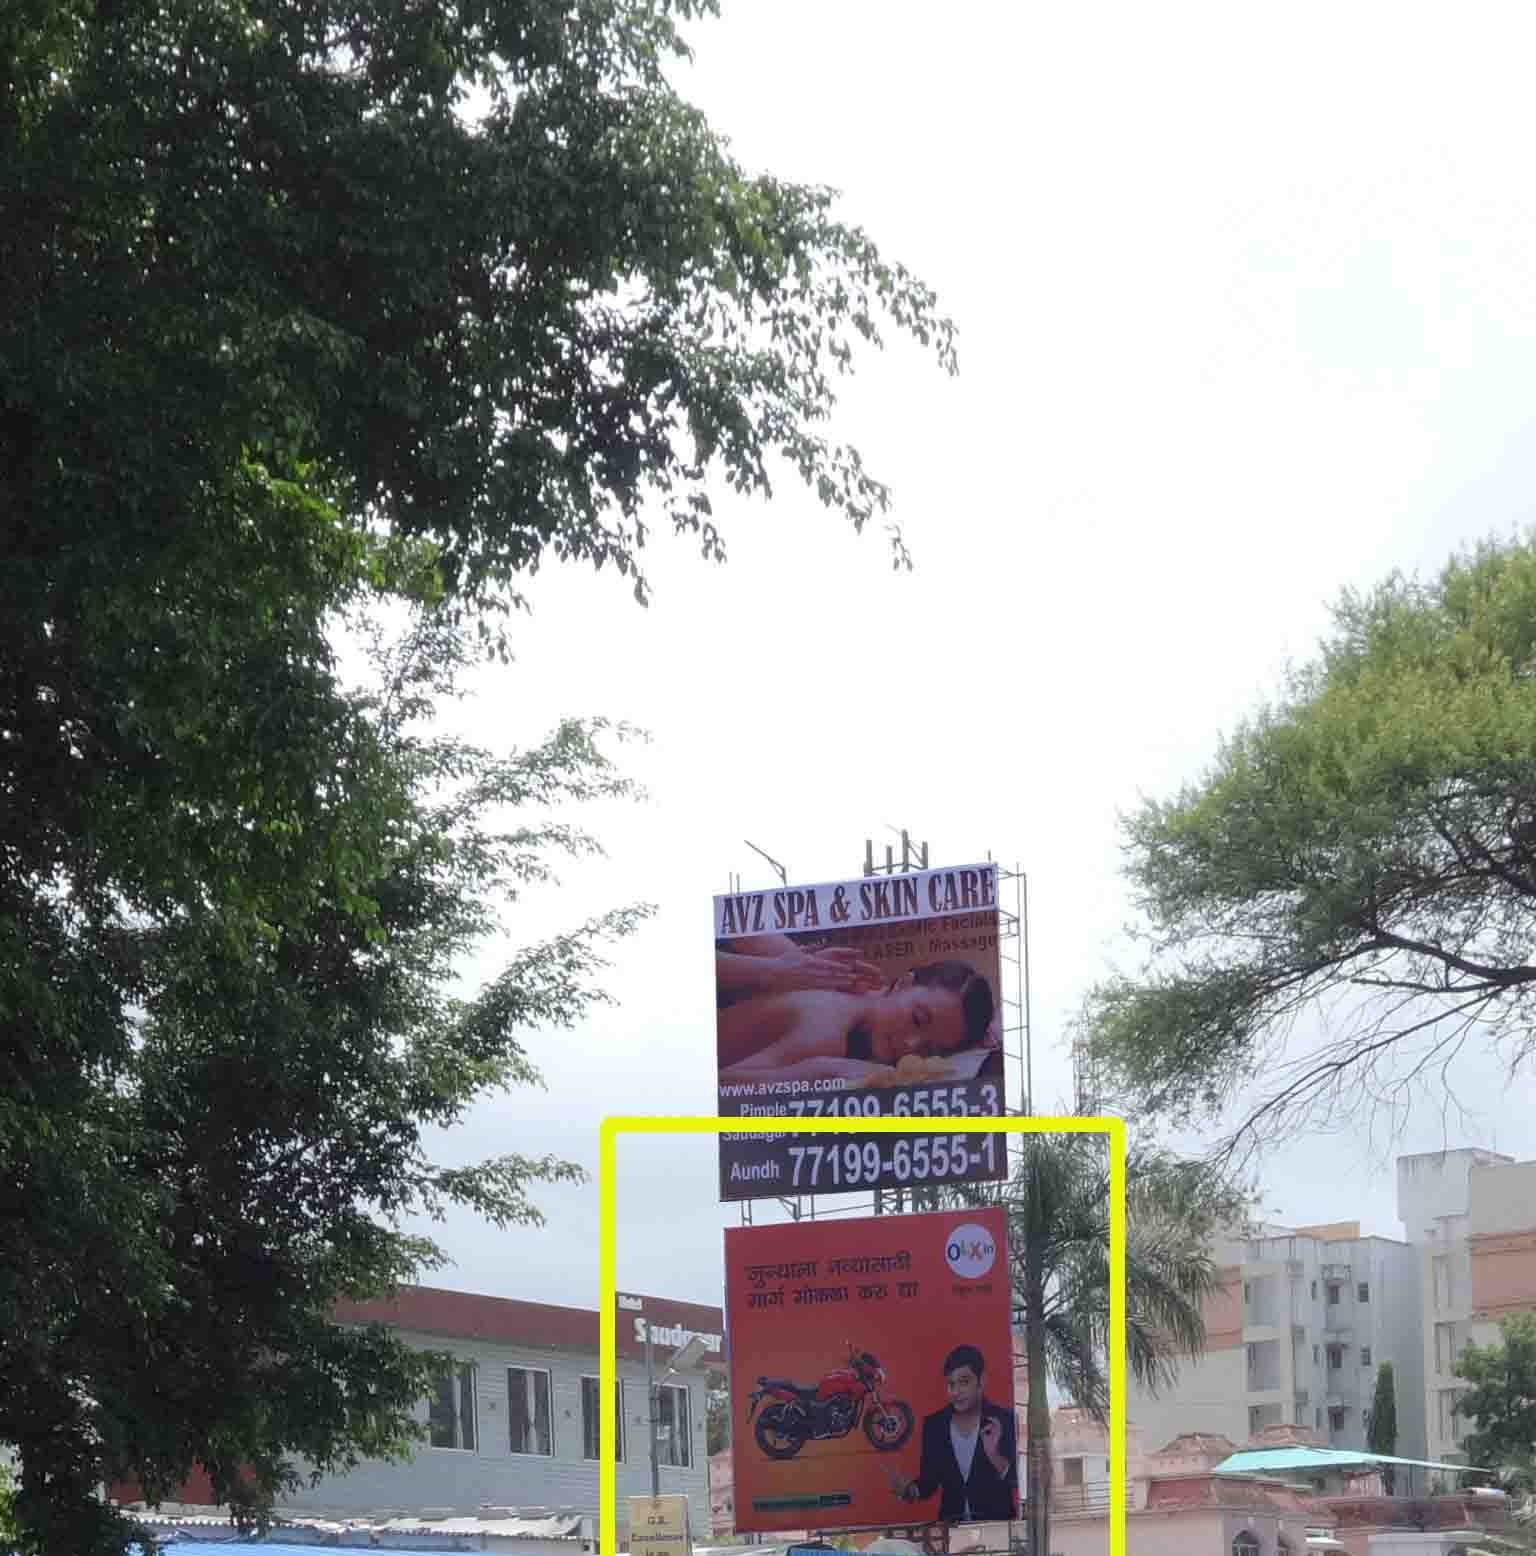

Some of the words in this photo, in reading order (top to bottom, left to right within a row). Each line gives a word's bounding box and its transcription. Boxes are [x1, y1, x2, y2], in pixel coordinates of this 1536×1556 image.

[722, 894, 765, 934] AVZ
[773, 889, 819, 930] SPA
[830, 886, 850, 922] &
[859, 877, 919, 921] SKIN
[928, 868, 996, 913] CARE
[719, 1077, 846, 1097] www.avzspa.com
[740, 1102, 787, 1118] Pimple
[730, 1161, 780, 1181] Aundh
[788, 1132, 995, 1187] 77199-6555-1
